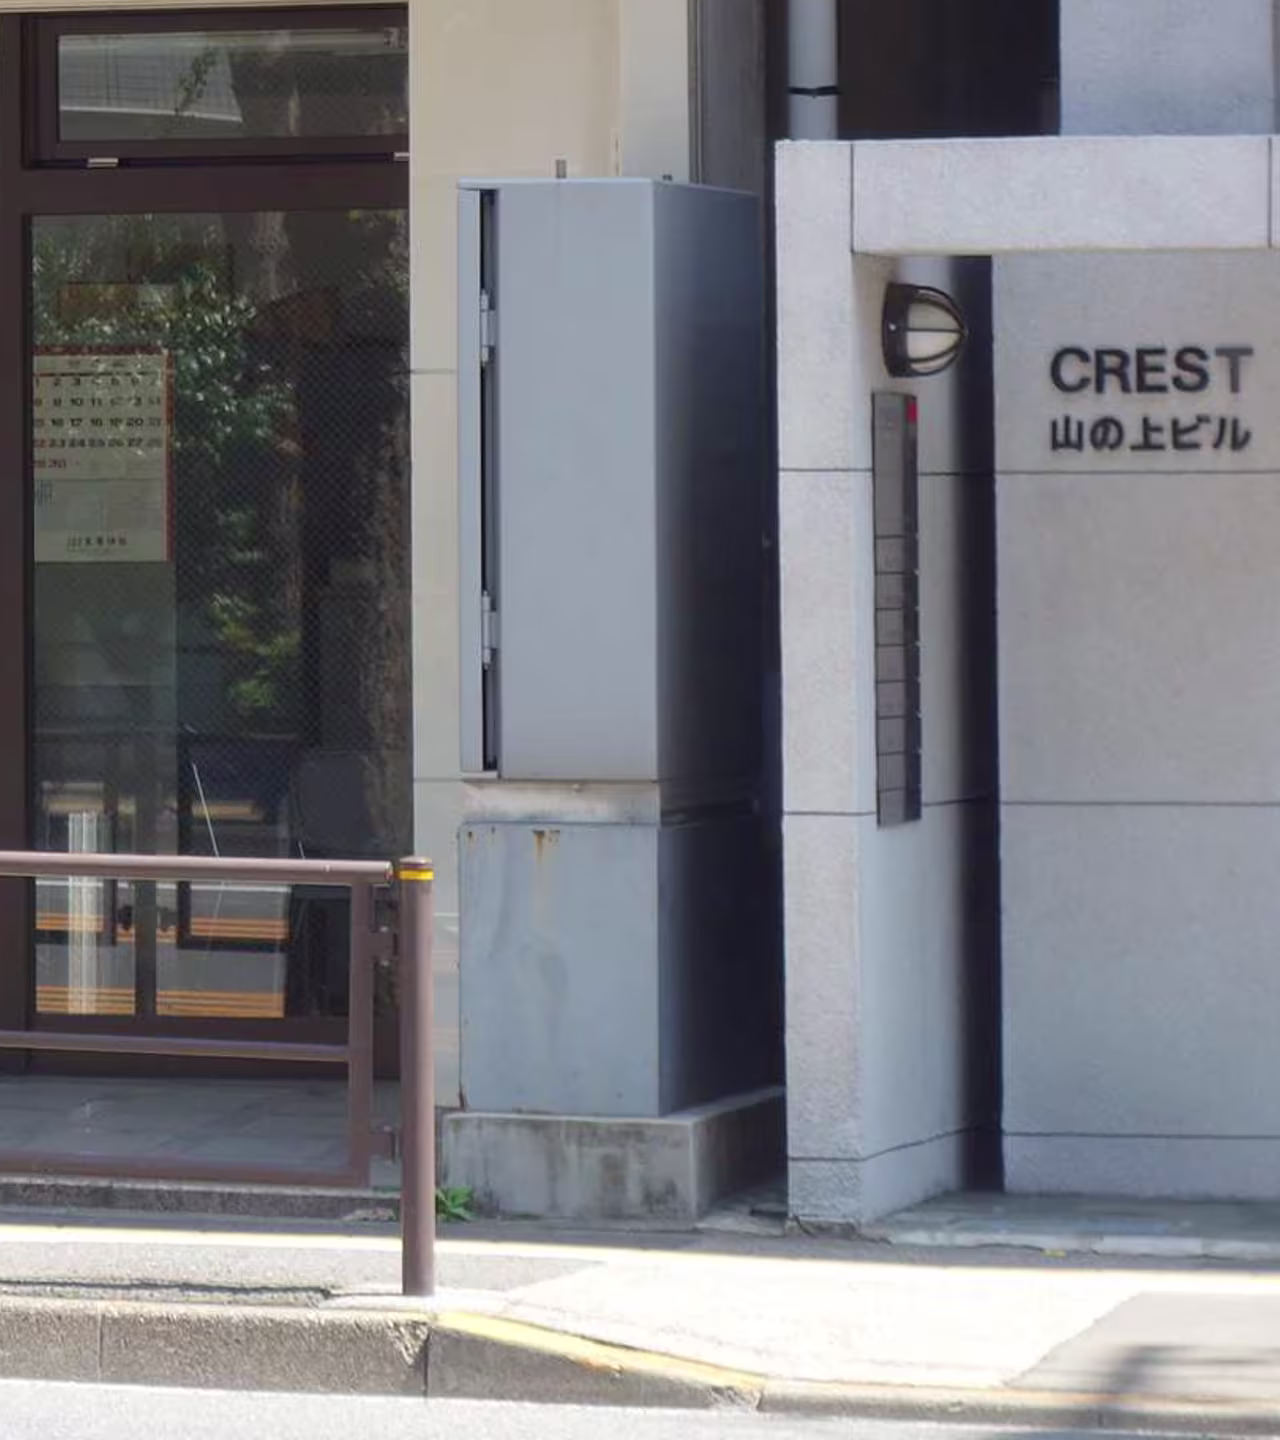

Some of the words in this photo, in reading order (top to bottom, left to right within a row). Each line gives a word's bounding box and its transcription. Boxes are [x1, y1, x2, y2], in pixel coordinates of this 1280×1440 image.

[1050, 346, 1254, 394] CREST
[1050, 415, 1252, 452] 山の上ビル
